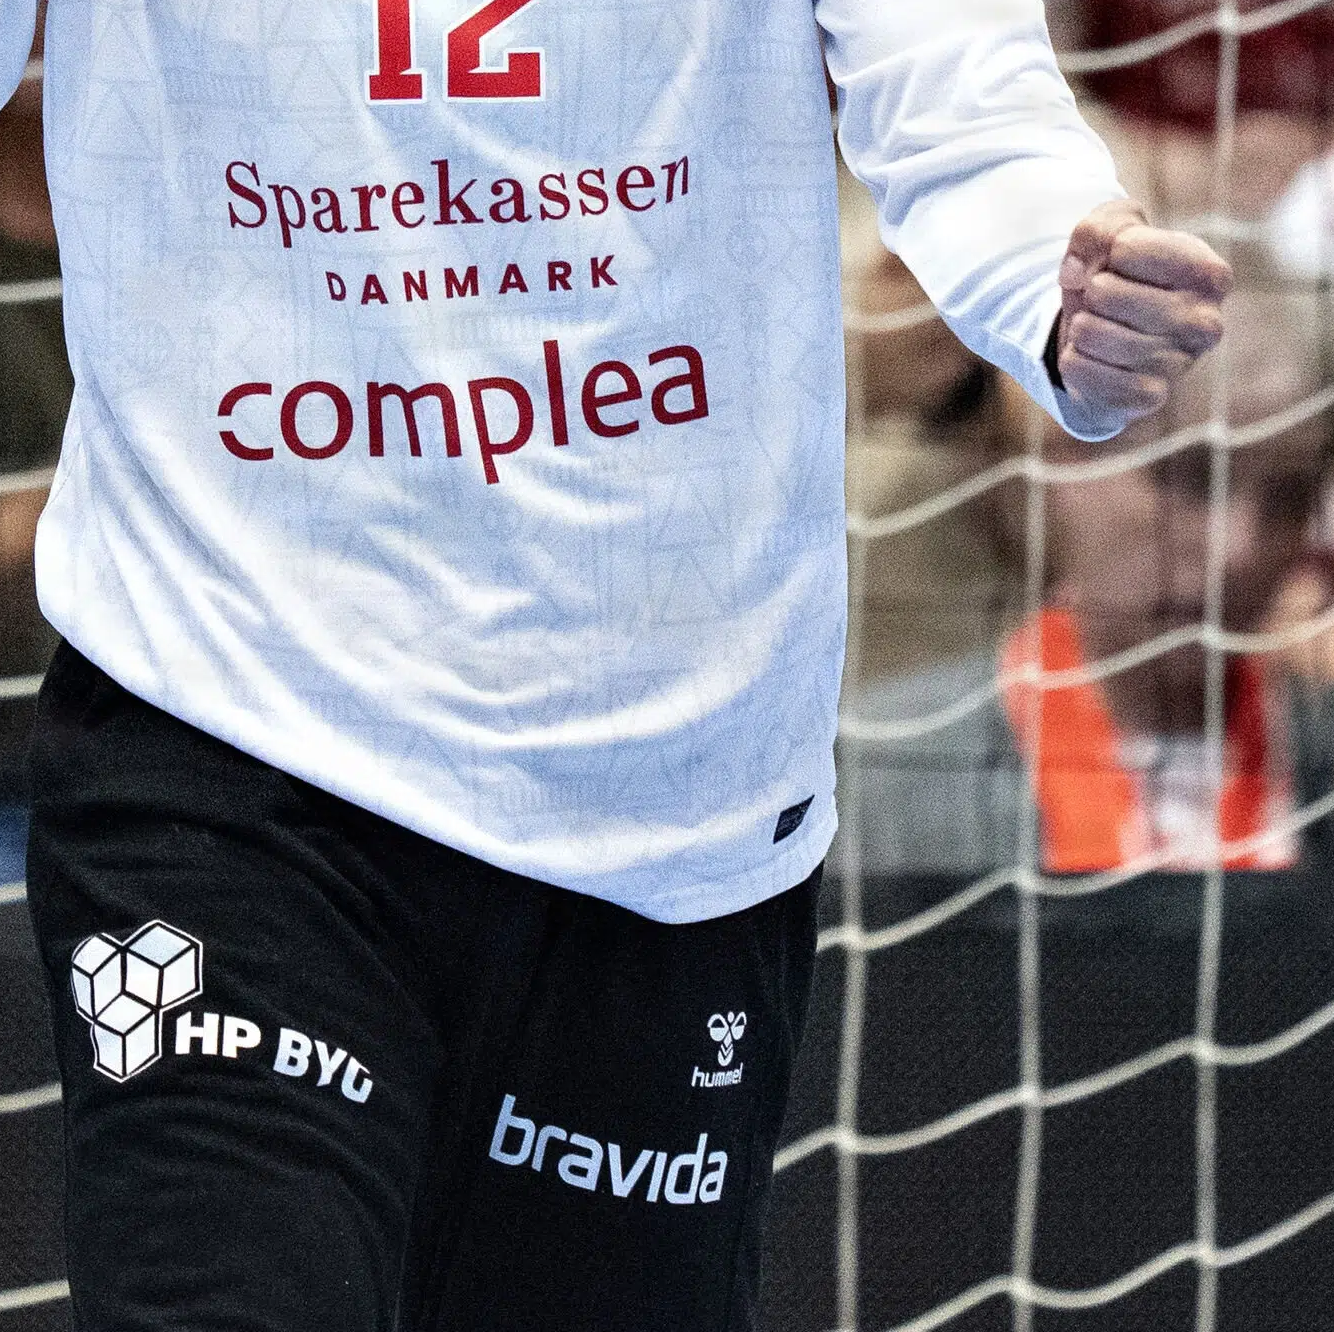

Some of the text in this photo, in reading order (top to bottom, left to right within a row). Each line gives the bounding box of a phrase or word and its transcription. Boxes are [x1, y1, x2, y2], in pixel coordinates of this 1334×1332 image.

[225, 156, 689, 248] Sparekassen
[325, 255, 618, 304] DANMARK
[217, 339, 709, 485] complea
[175, 1010, 373, 1104] HP BYG
[691, 1062, 744, 1087] hummel
[489, 1093, 728, 1205] bravida
